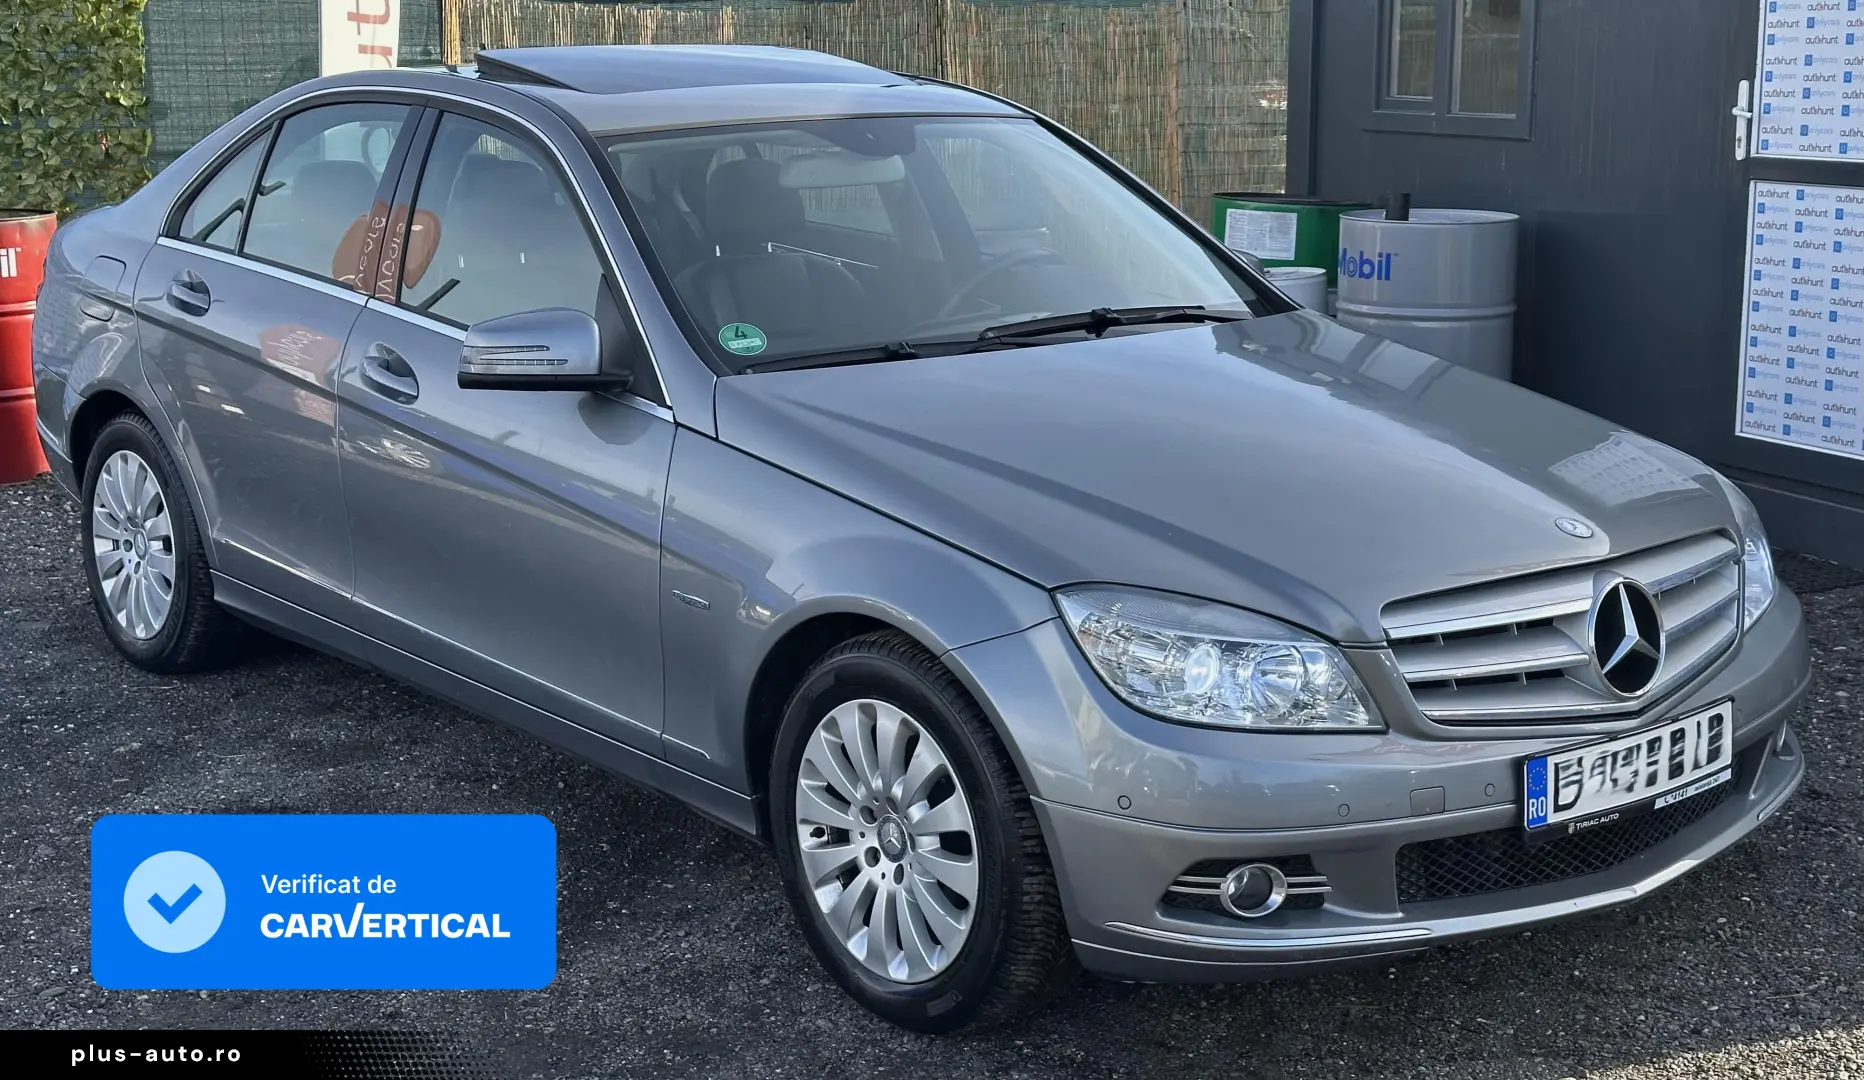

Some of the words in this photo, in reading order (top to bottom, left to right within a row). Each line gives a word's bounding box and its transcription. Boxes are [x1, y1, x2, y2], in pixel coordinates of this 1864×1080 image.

[734, 325, 748, 338] 4
[1529, 796, 1547, 820] RO
[1576, 818, 1599, 830] TIRIAC
[1600, 812, 1619, 824] AUTO
